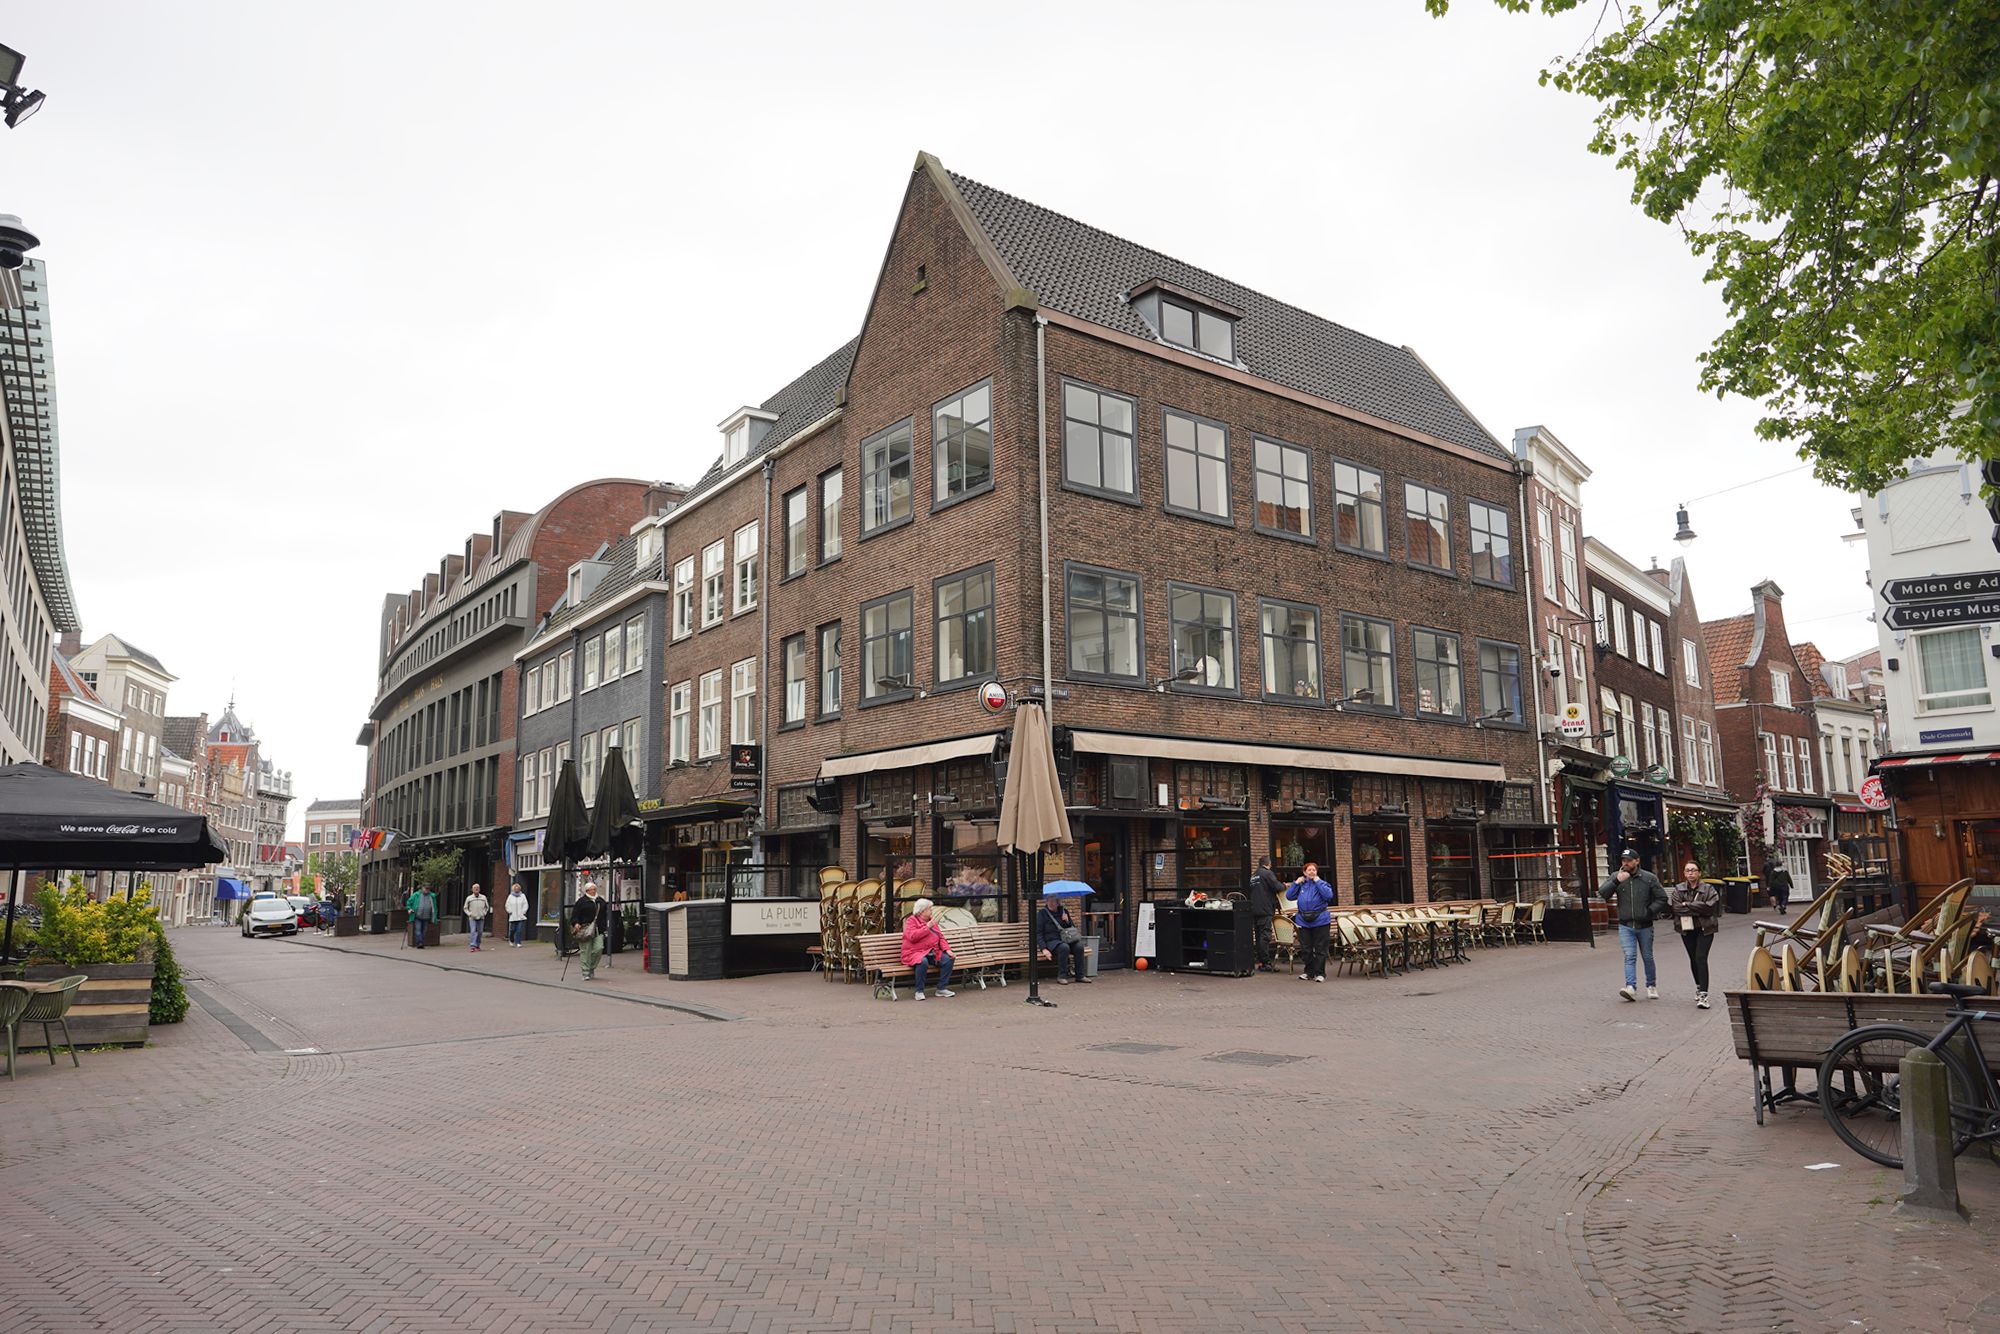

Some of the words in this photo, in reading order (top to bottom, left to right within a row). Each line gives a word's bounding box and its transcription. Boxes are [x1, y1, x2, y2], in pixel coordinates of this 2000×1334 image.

[1902, 583, 1947, 595] Molen
[1953, 580, 1972, 590] de
[1978, 577, 1999, 588] Ad
[1903, 607, 1961, 620] Teylers
[1967, 604, 2000, 615] Mus
[1562, 719, 1585, 727] Brand
[60, 824, 76, 832] We
[78, 825, 104, 833] serve
[761, 907, 774, 920] LA
[776, 907, 809, 919] PLUME
